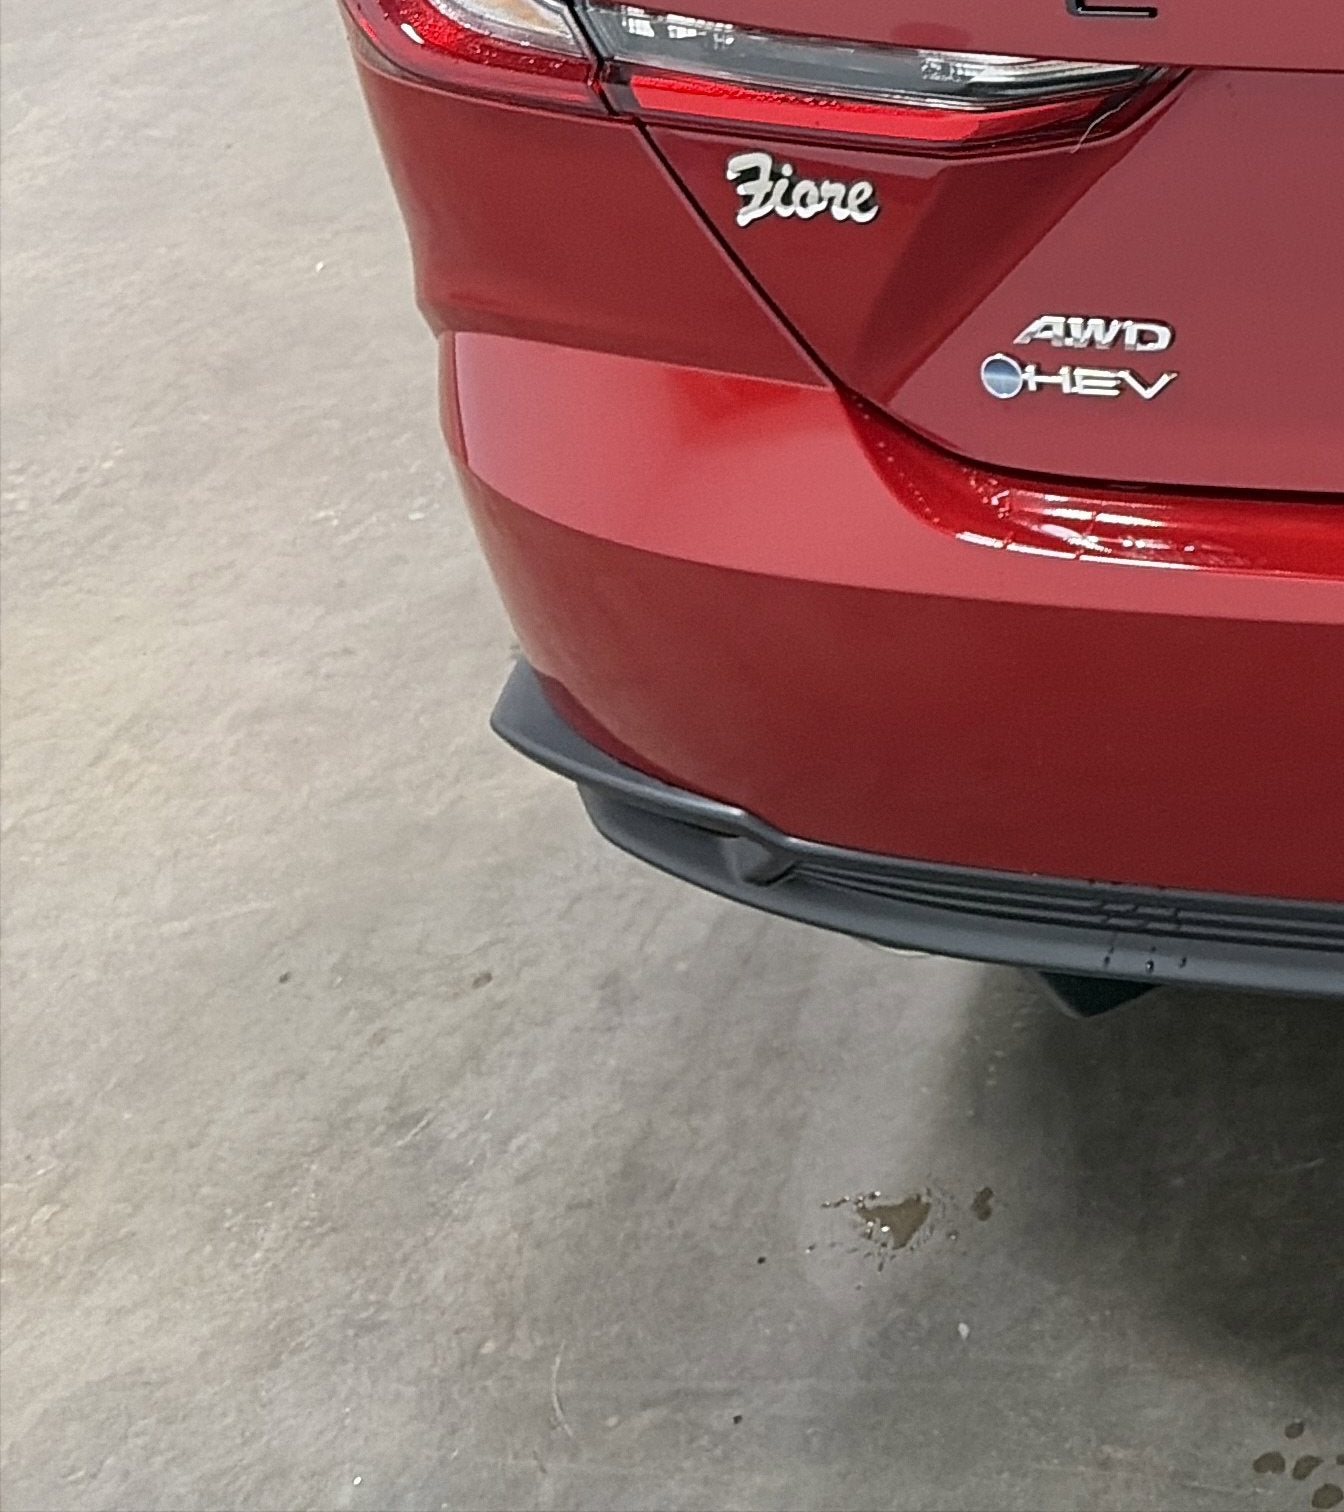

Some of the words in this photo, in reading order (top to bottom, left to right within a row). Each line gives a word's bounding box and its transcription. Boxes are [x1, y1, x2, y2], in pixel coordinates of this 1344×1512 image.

[727, 150, 880, 227] Fiore
[1012, 314, 1174, 352] AWD
[1021, 363, 1179, 400] HEV
